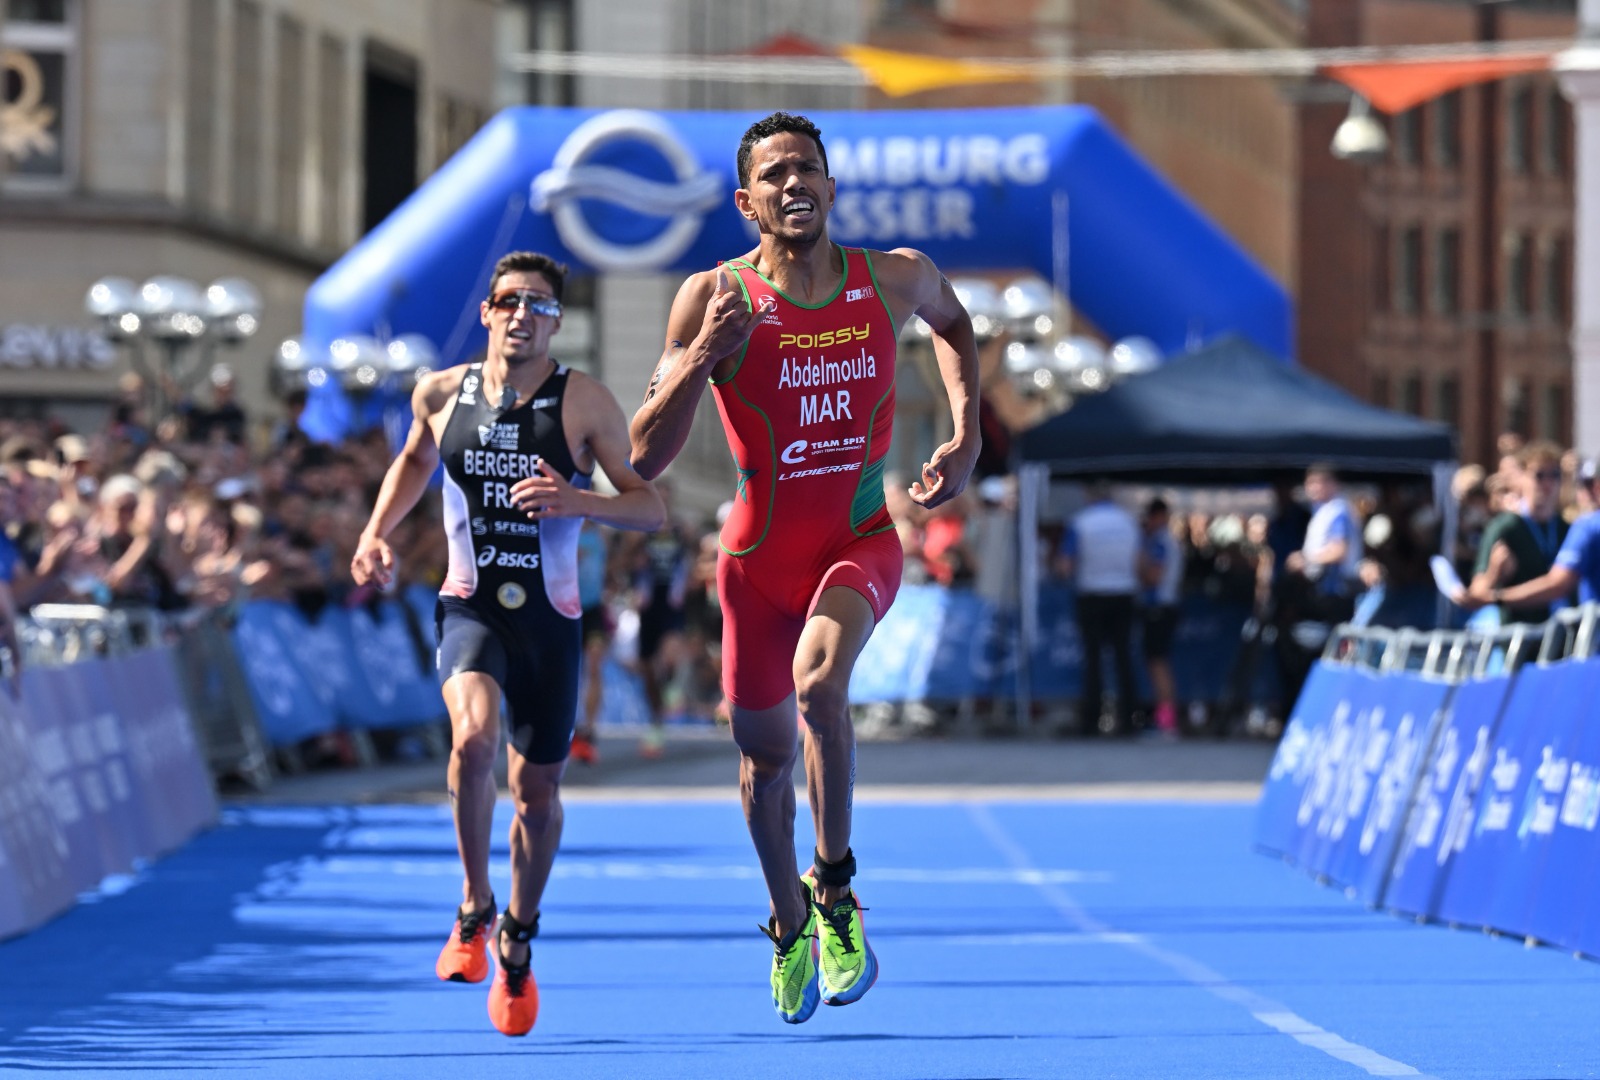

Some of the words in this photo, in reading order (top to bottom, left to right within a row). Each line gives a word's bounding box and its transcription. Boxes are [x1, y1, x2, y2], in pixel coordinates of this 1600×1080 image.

[827, 134, 1049, 186] MBURG
[778, 323, 870, 349] POISSY
[778, 348, 876, 389] Abdelmoula
[800, 390, 852, 427] MAR
[811, 439, 840, 449] TEAM
[843, 436, 865, 446] SPIX
[463, 449, 541, 478] BERGERE
[778, 461, 863, 481] LAPIERRE
[494, 520, 538, 534] SFERIS
[497, 551, 540, 568] asics
